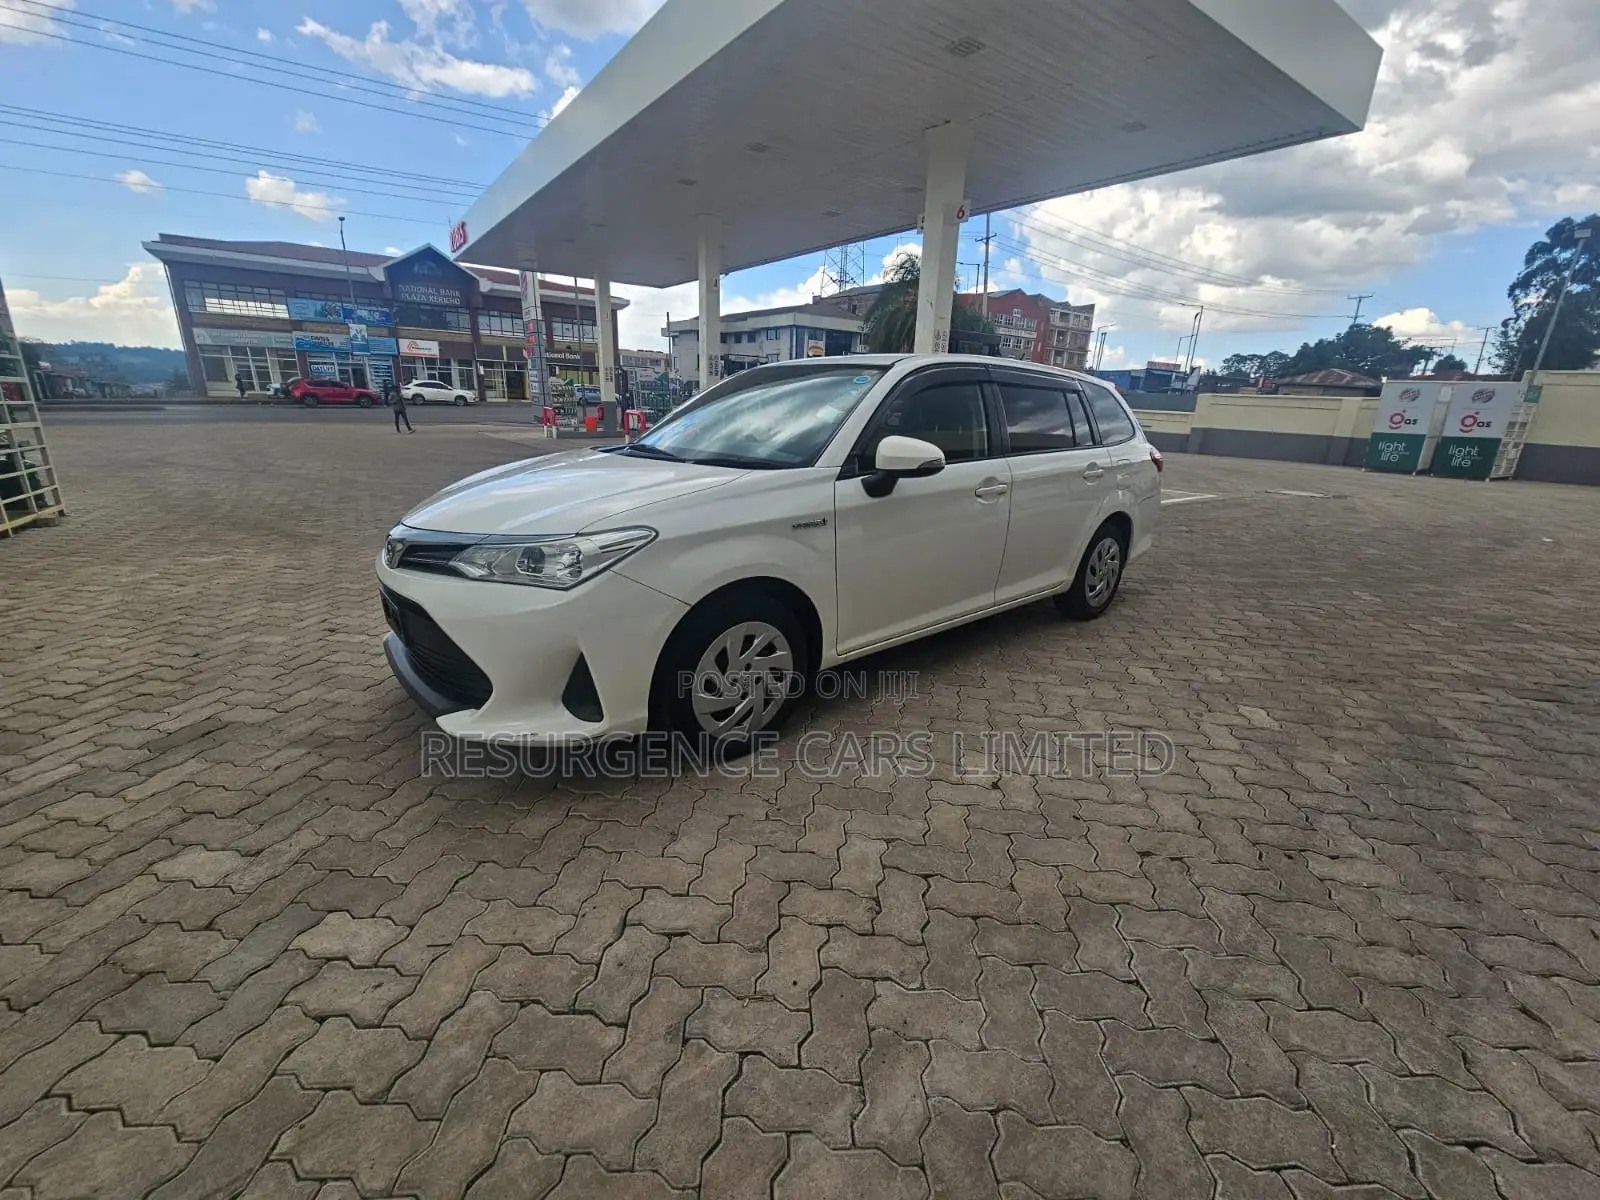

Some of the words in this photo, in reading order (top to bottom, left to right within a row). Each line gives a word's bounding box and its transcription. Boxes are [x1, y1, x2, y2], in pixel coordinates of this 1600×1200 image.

[956, 204, 965, 220] 6
[398, 284, 437, 295] NATIONAL
[440, 288, 461, 297] BANK
[401, 293, 427, 301] PLAZA
[429, 295, 461, 305] KERICHO
[1388, 409, 1418, 430] gas
[1459, 412, 1492, 433] gas
[1378, 441, 1407, 453] light
[1448, 444, 1480, 457] light
[1381, 452, 1399, 462] life
[1451, 455, 1472, 467] life
